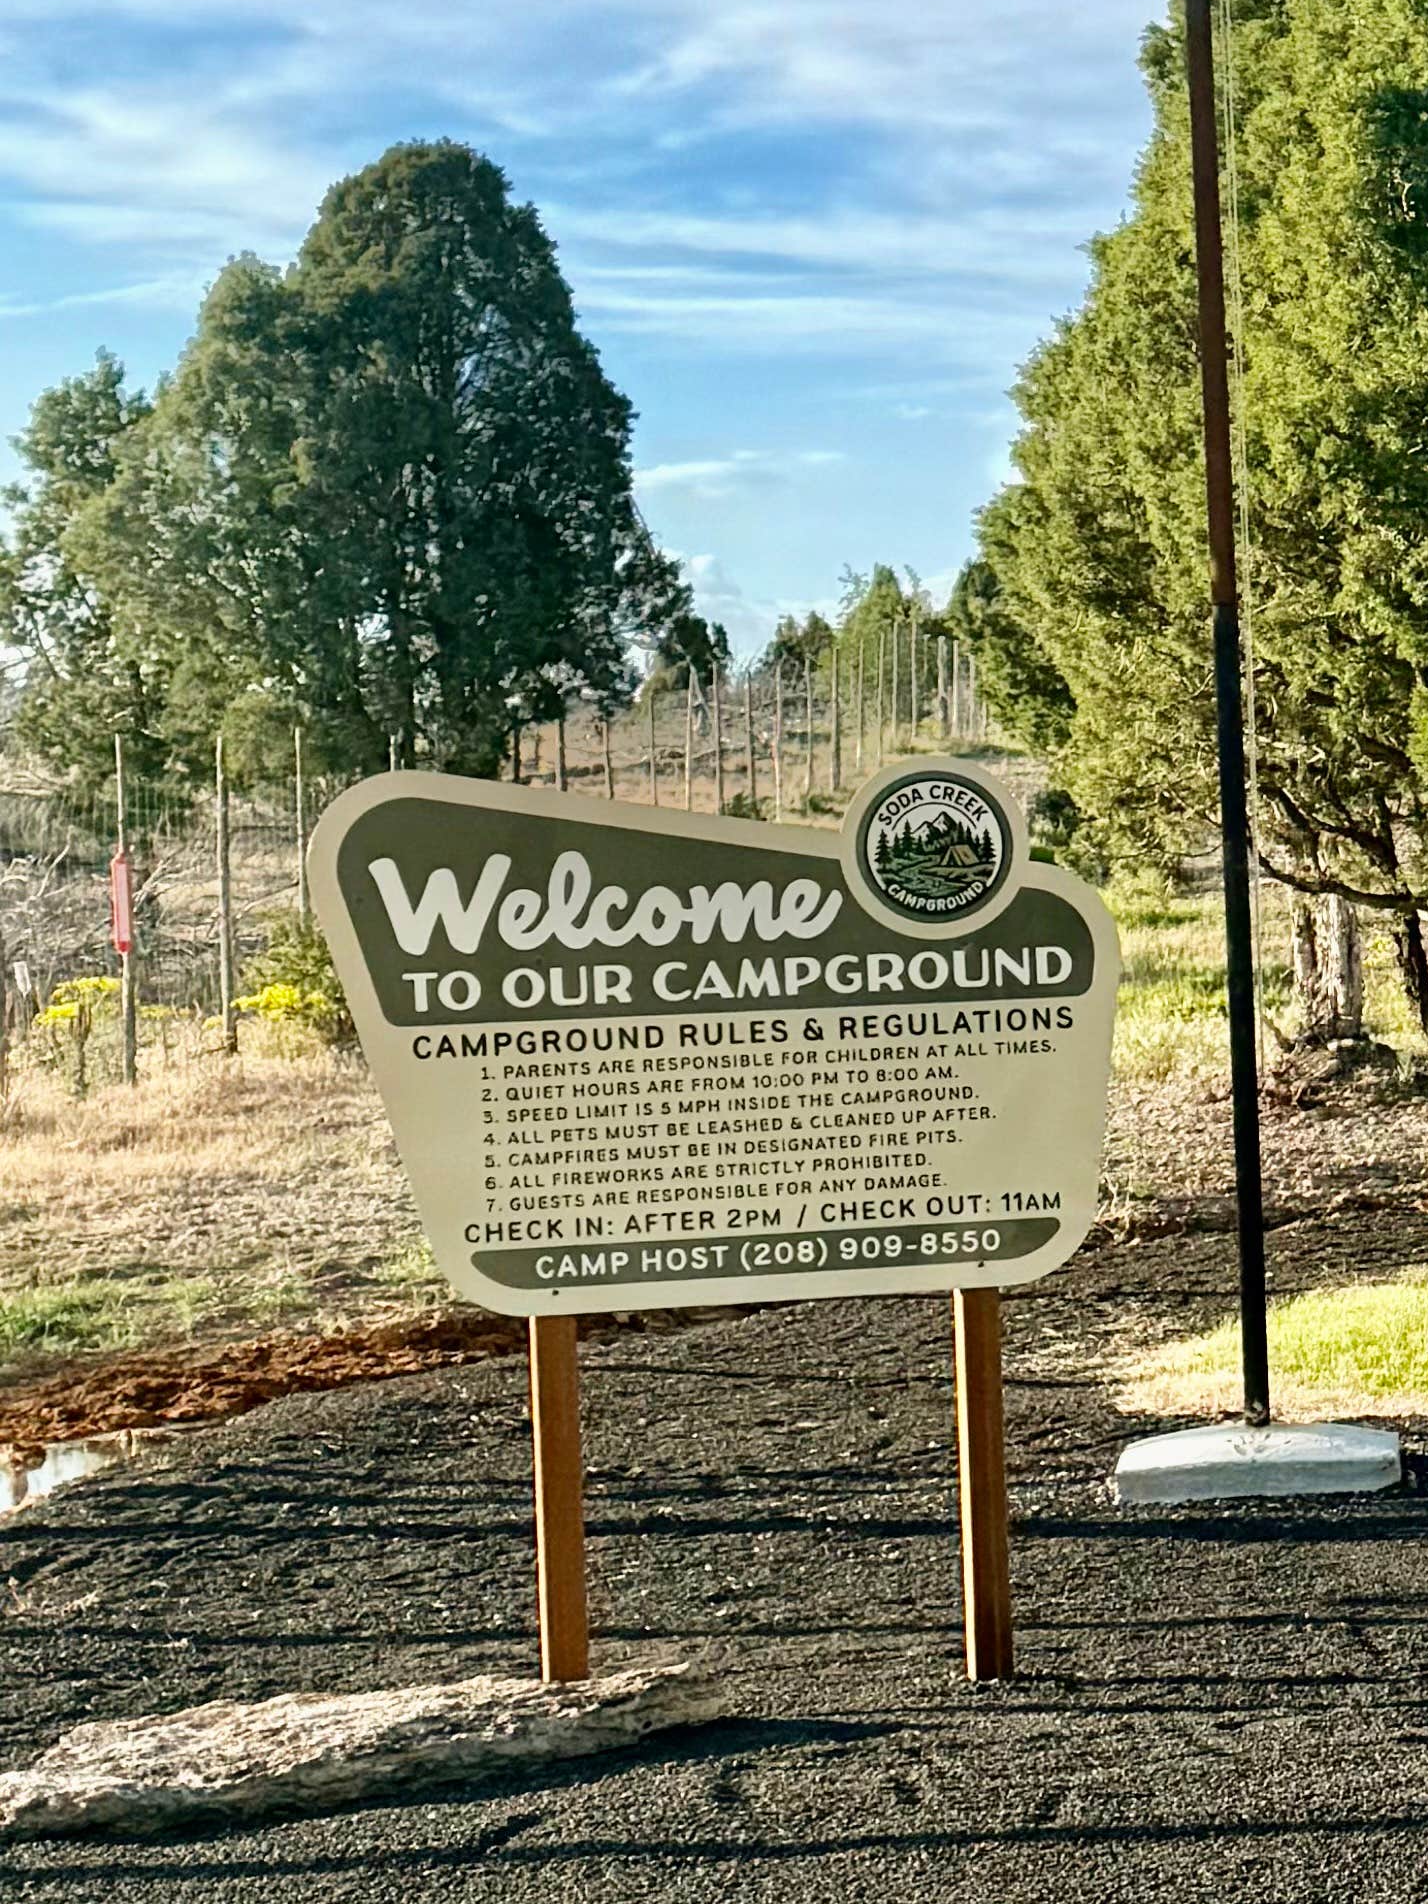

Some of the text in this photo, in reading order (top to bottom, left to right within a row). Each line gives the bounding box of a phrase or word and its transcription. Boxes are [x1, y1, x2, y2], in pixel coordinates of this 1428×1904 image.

[878, 785, 988, 826] SODA CREEK
[368, 851, 843, 956] Welcome
[888, 880, 983, 911] CAMPGROUND
[402, 946, 1072, 1012] TO OUR CAMPGROUND
[413, 1006, 1073, 1059] CAMPGROUND RULES & REGULATIONS
[481, 1039, 1056, 1080] 1. PARENTS ARE RESPONSIBLE FOR CHILDREN AT ALL TIMES.
[481, 1088, 498, 1102] 2.
[506, 1085, 565, 1101] QUIET
[573, 1081, 640, 1098] HOURS
[647, 1079, 683, 1093] ARE
[692, 1076, 745, 1091] FROM
[752, 1073, 804, 1088] 10:00
[812, 1072, 838, 1085] PM
[846, 1070, 869, 1083] TO
[925, 1066, 959, 1079] AM.
[507, 1107, 568, 1123] SPEED
[576, 1104, 628, 1119] LIMIT
[636, 1102, 653, 1116] IS
[661, 1102, 671, 1115] 5
[679, 1099, 720, 1113] MPH
[728, 1095, 790, 1111] INSIDE
[797, 1093, 834, 1108] THE
[841, 1086, 979, 1105] CAMPGROUND.
[483, 1106, 996, 1145] 4. ALL PETS MUST BE LEASHED & CLEANED UP AFTER.
[485, 1129, 962, 1168] 5. CAMPFIRES MUST BE IN DESIGNATED FIRE PITS.
[509, 1175, 545, 1188] ALL
[553, 1167, 664, 1186] FIREWORKS
[671, 1165, 708, 1179] ARE
[716, 1160, 805, 1178] STRICTLY
[813, 1153, 932, 1172] PROHIBITED.
[486, 1173, 947, 1212] 7. GUESTS ARE RESPONSIBLE FOR ANY DAMAGE.
[465, 1192, 1060, 1243] CHECK IN: AFTER 2PM / CHECK OUT: 11AM
[536, 1229, 1000, 1279] CAMP HOST (208) 909-8550
